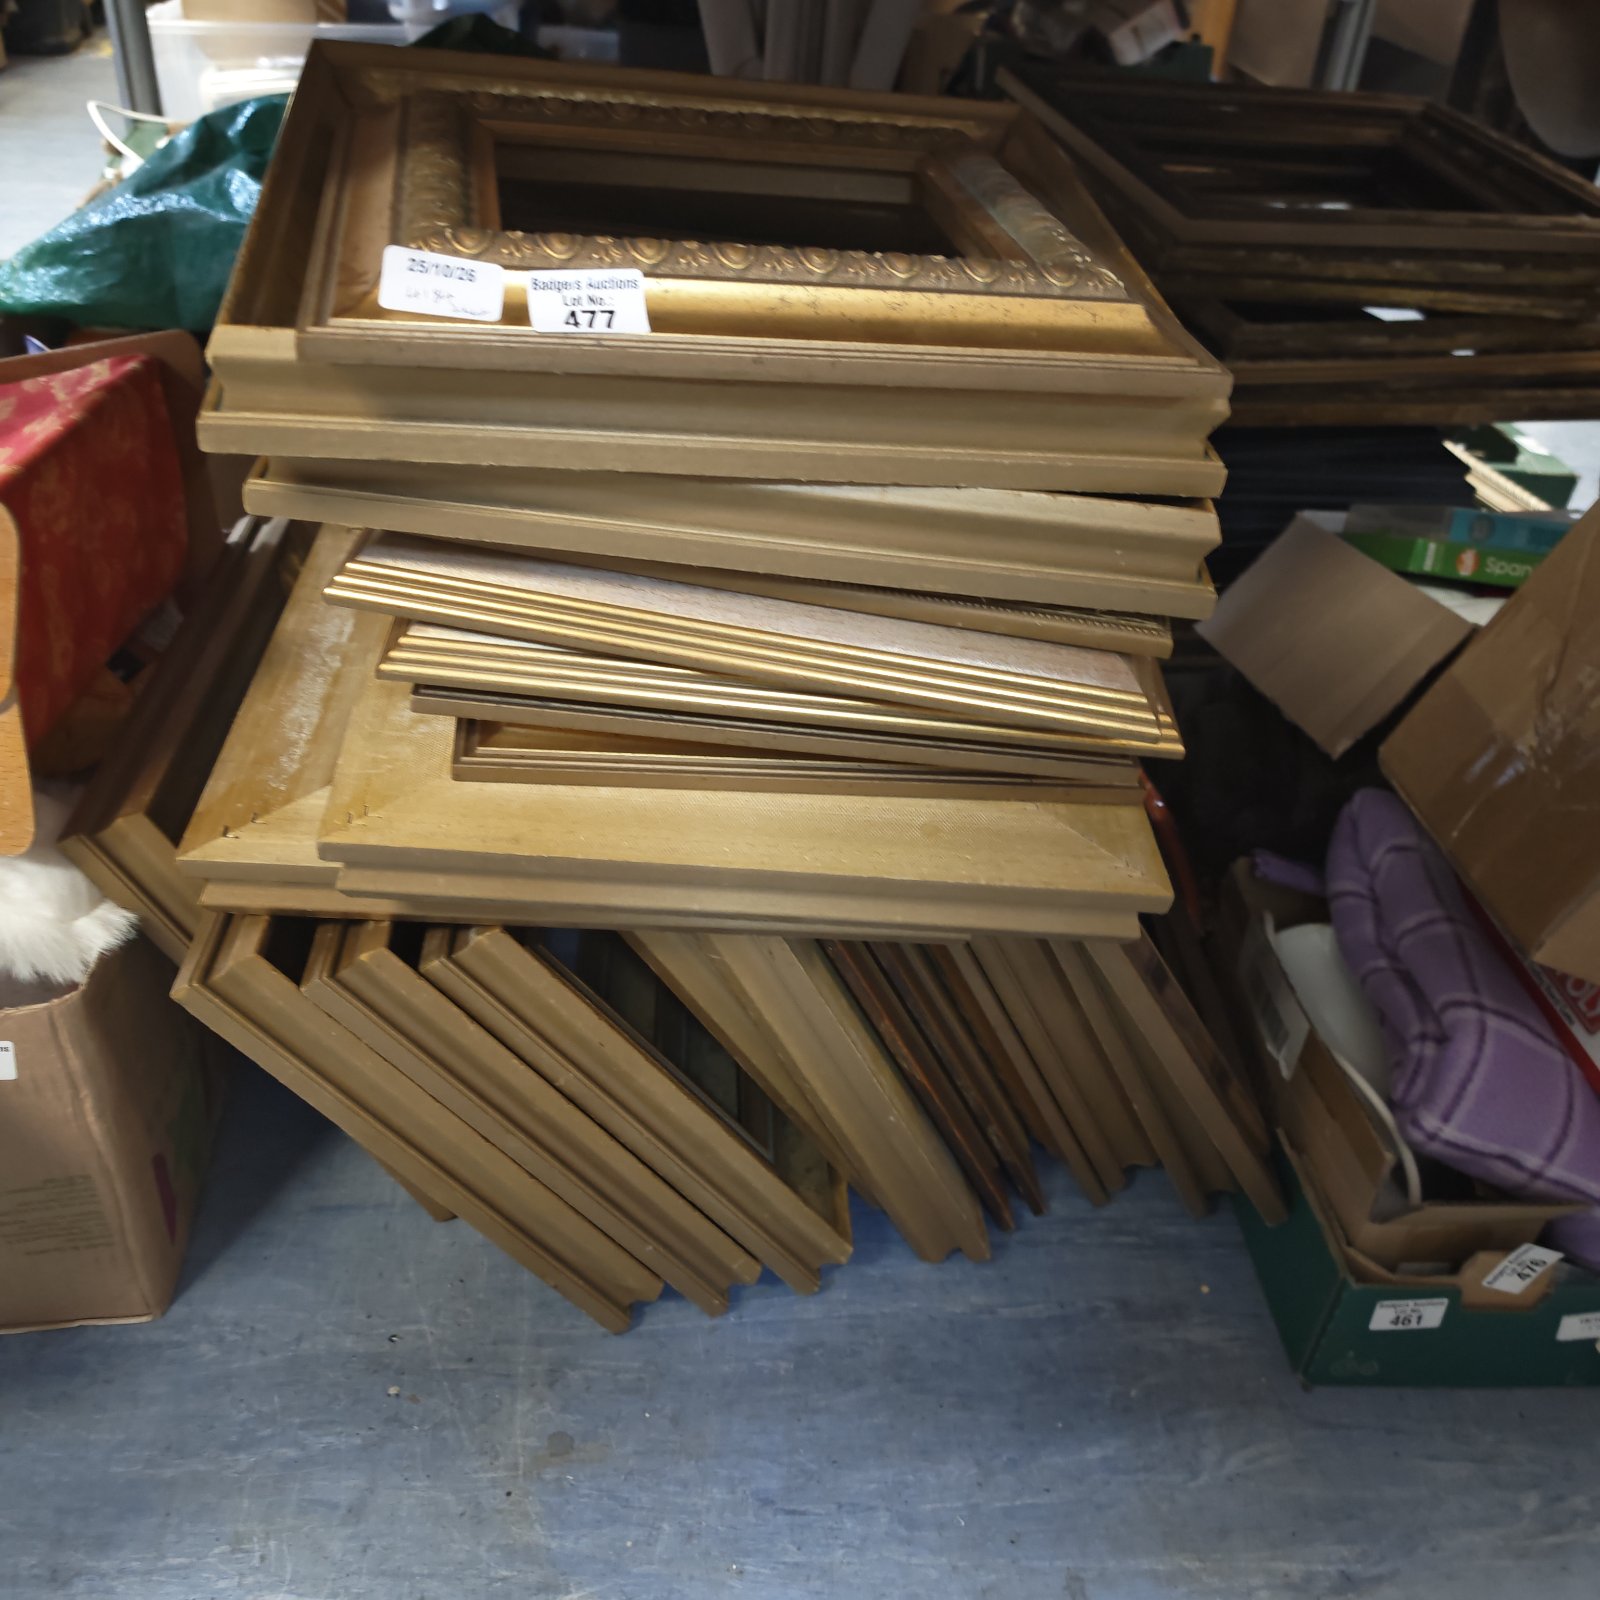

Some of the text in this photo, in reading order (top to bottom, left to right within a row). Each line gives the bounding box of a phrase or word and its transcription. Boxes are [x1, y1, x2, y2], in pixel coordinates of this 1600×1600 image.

[531, 276, 639, 293] Badgers Auctions
[562, 295, 583, 307] Lot
[564, 310, 616, 329] 477
[1485, 556, 1533, 577] Span
[1389, 1314, 1422, 1327] 461
